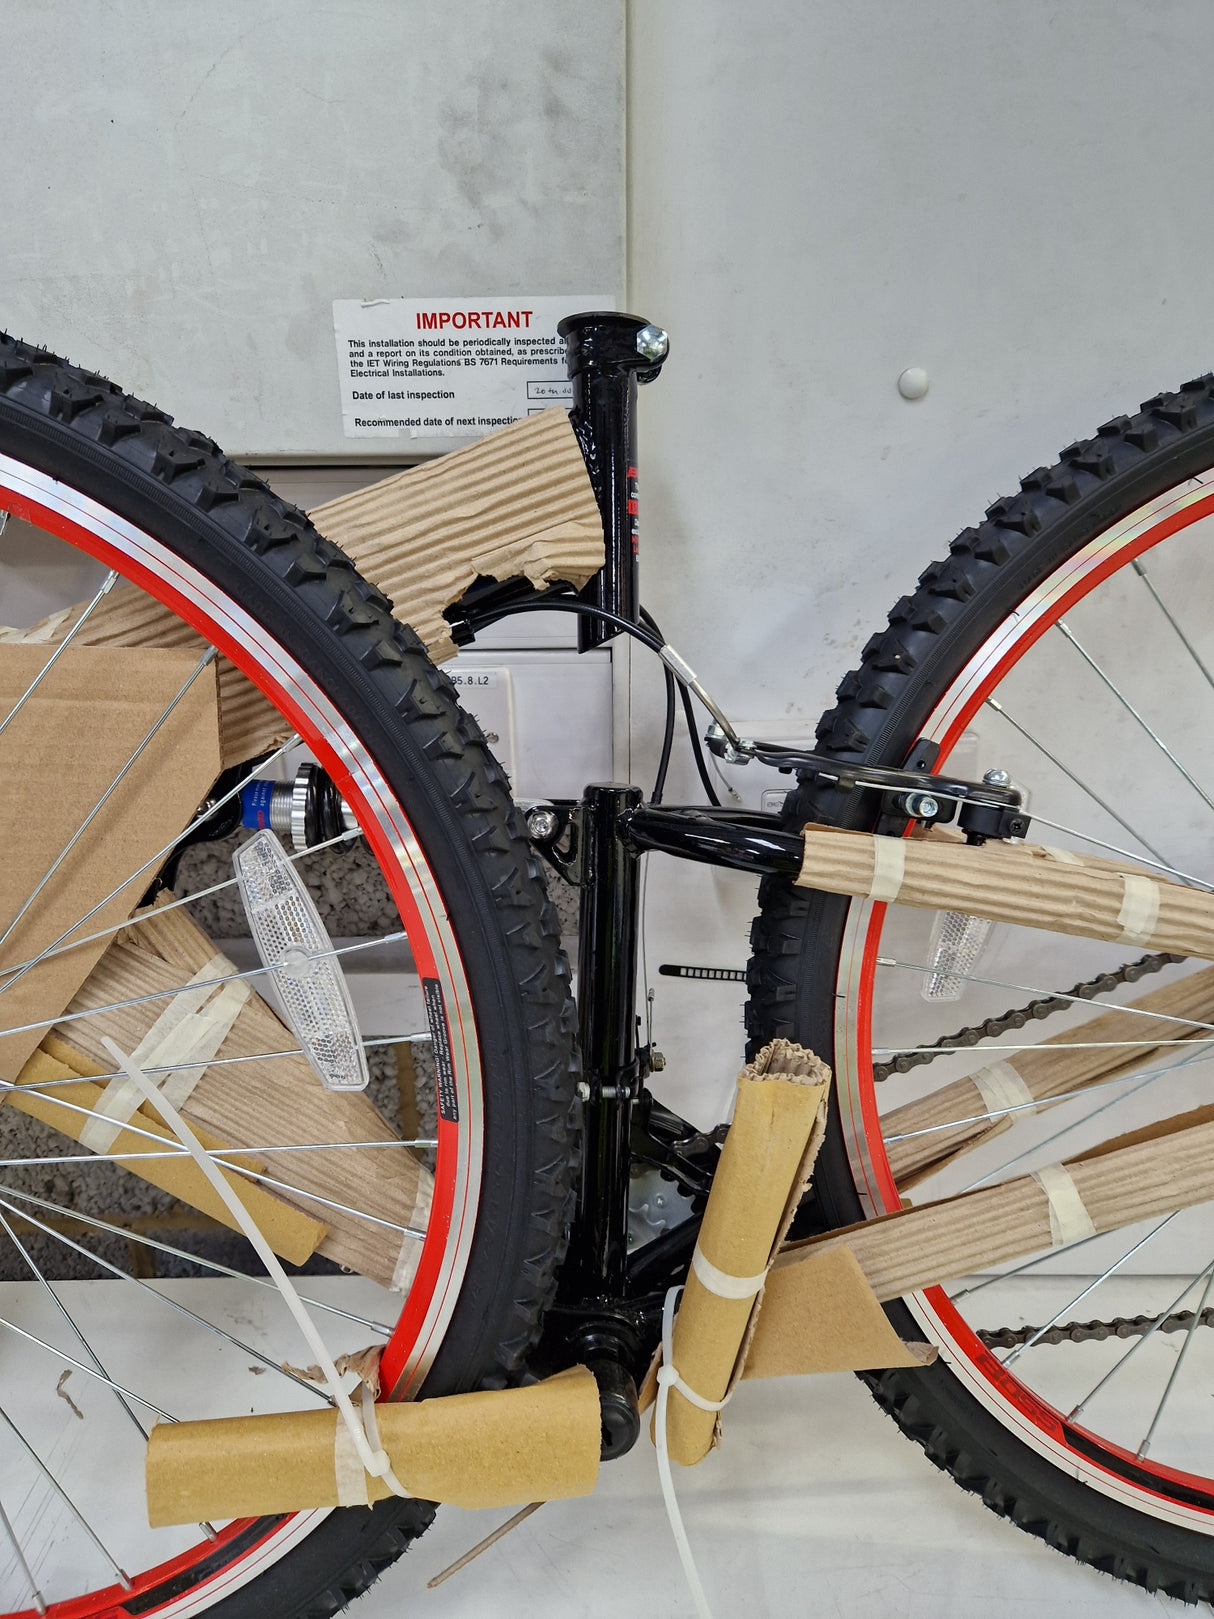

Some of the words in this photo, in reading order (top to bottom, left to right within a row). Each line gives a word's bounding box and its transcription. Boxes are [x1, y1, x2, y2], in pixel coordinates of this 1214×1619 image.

[416, 311, 533, 330] IMPORTANT
[348, 339, 365, 348] This
[369, 339, 414, 347] installation
[418, 339, 445, 347] should
[449, 338, 459, 346] be
[463, 338, 511, 347] periodically
[514, 337, 555, 347] inspected
[349, 350, 365, 358] and
[377, 350, 402, 358] report
[419, 349, 430, 357] its
[433, 348, 472, 356] condition
[475, 348, 514, 357] obtained,
[383, 359, 409, 368] Wiring
[412, 358, 461, 368] Regulations
[464, 358, 476, 366] BS
[479, 358, 498, 366] 7671
[501, 357, 558, 366] Requirements
[350, 369, 389, 377] Electrical
[392, 369, 445, 377] Installations.
[352, 391, 373, 400] Date
[375, 391, 385, 399] of
[388, 391, 405, 399] last
[407, 390, 455, 401] inspection
[355, 418, 421, 427] Recommended
[423, 418, 442, 426] date
[444, 417, 454, 426] of
[456, 417, 476, 426] next
[478, 416, 522, 427] inspectio
